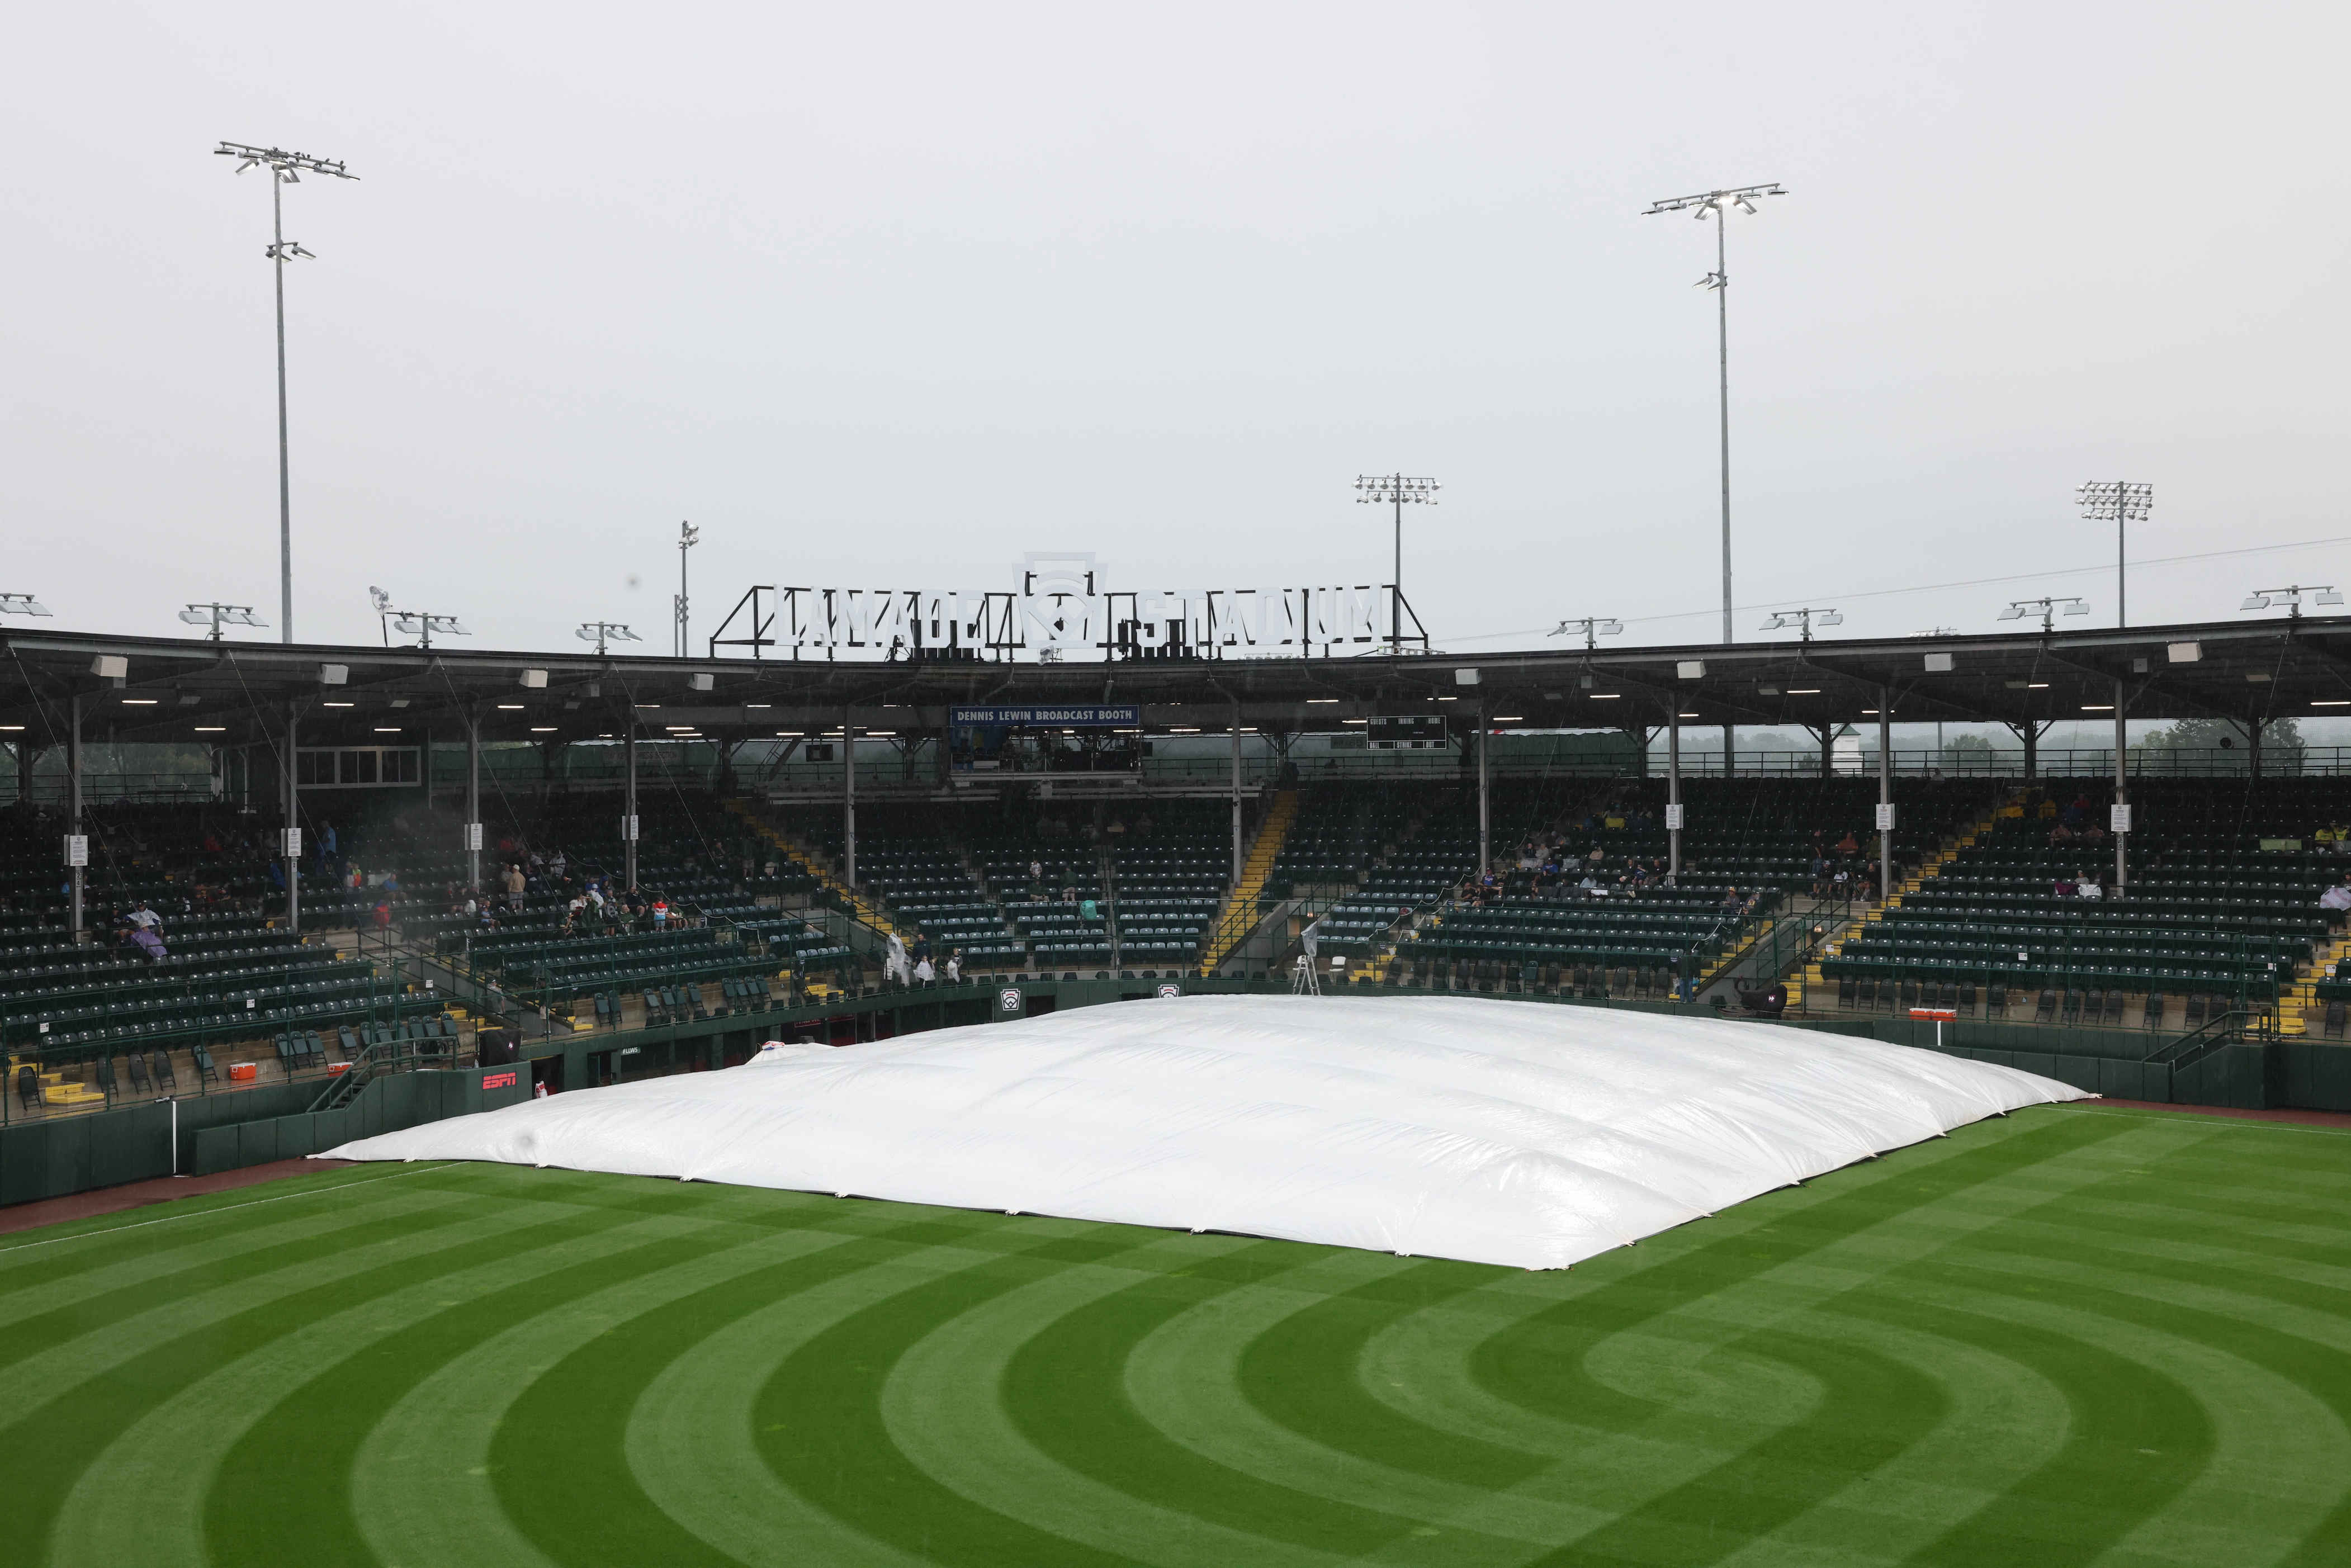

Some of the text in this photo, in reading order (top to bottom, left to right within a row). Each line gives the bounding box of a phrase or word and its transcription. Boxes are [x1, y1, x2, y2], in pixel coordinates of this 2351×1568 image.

[774, 582, 1383, 648] LAMADE STADIUM
[957, 710, 1132, 721] DENNIS LEWIN BROADCAST BOOTH
[483, 1072, 516, 1089] ESPN
